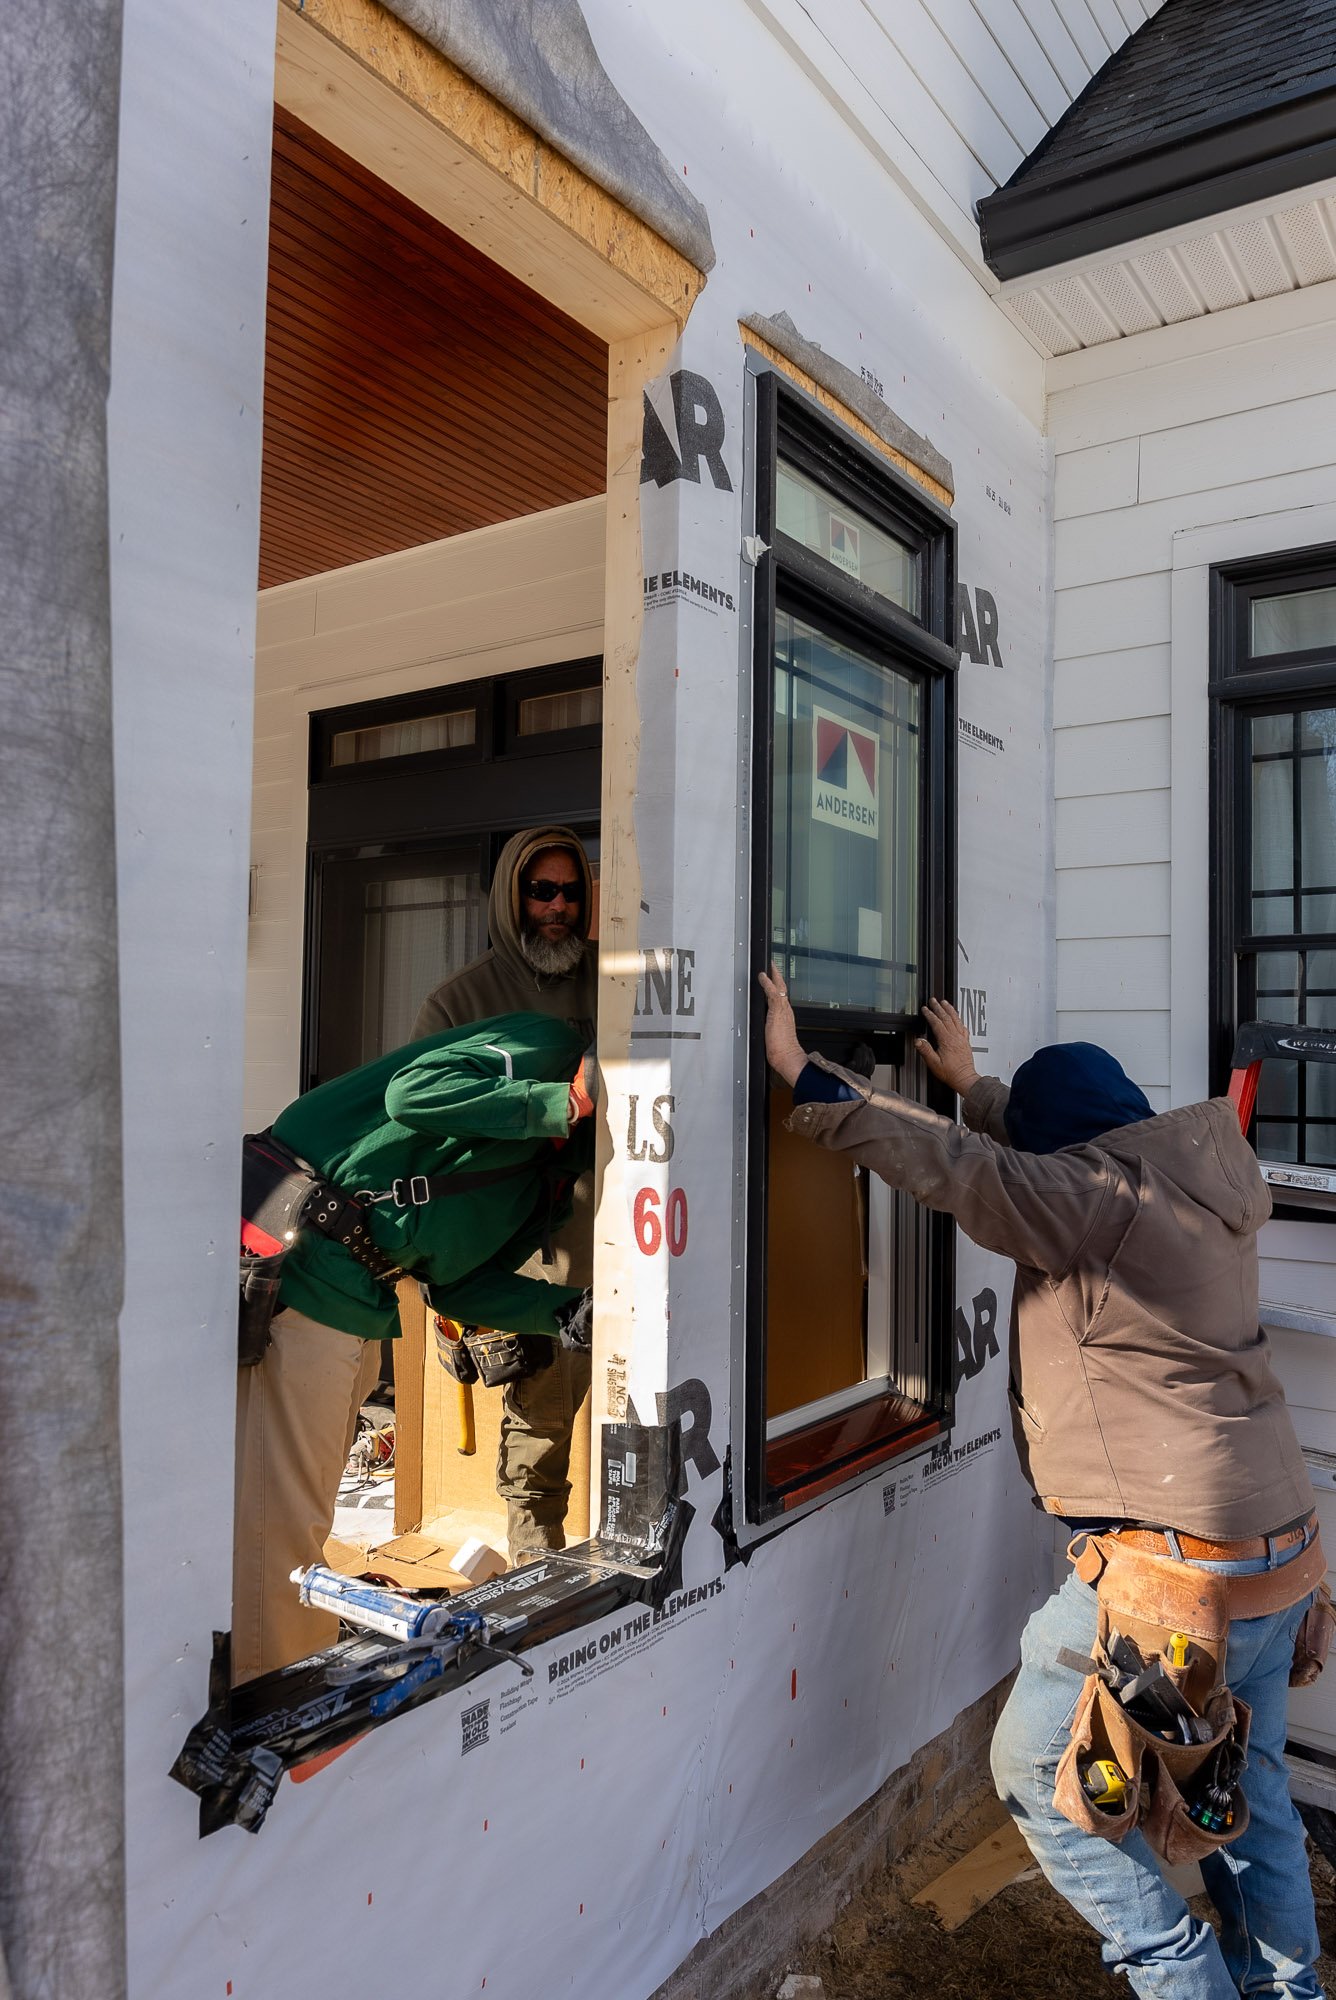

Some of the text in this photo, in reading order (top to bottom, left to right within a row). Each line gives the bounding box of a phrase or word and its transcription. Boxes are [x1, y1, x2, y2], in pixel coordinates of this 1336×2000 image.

[661, 570, 737, 613] ELEMENTS.
[958, 717, 972, 735] THE
[816, 791, 876, 827] ANDERSEN
[633, 1187, 689, 1258] 60
[953, 1446, 966, 1462] THE
[548, 1576, 726, 1684] BRING ON THE ELEMENTS.
[471, 1720, 489, 1737] OLD
